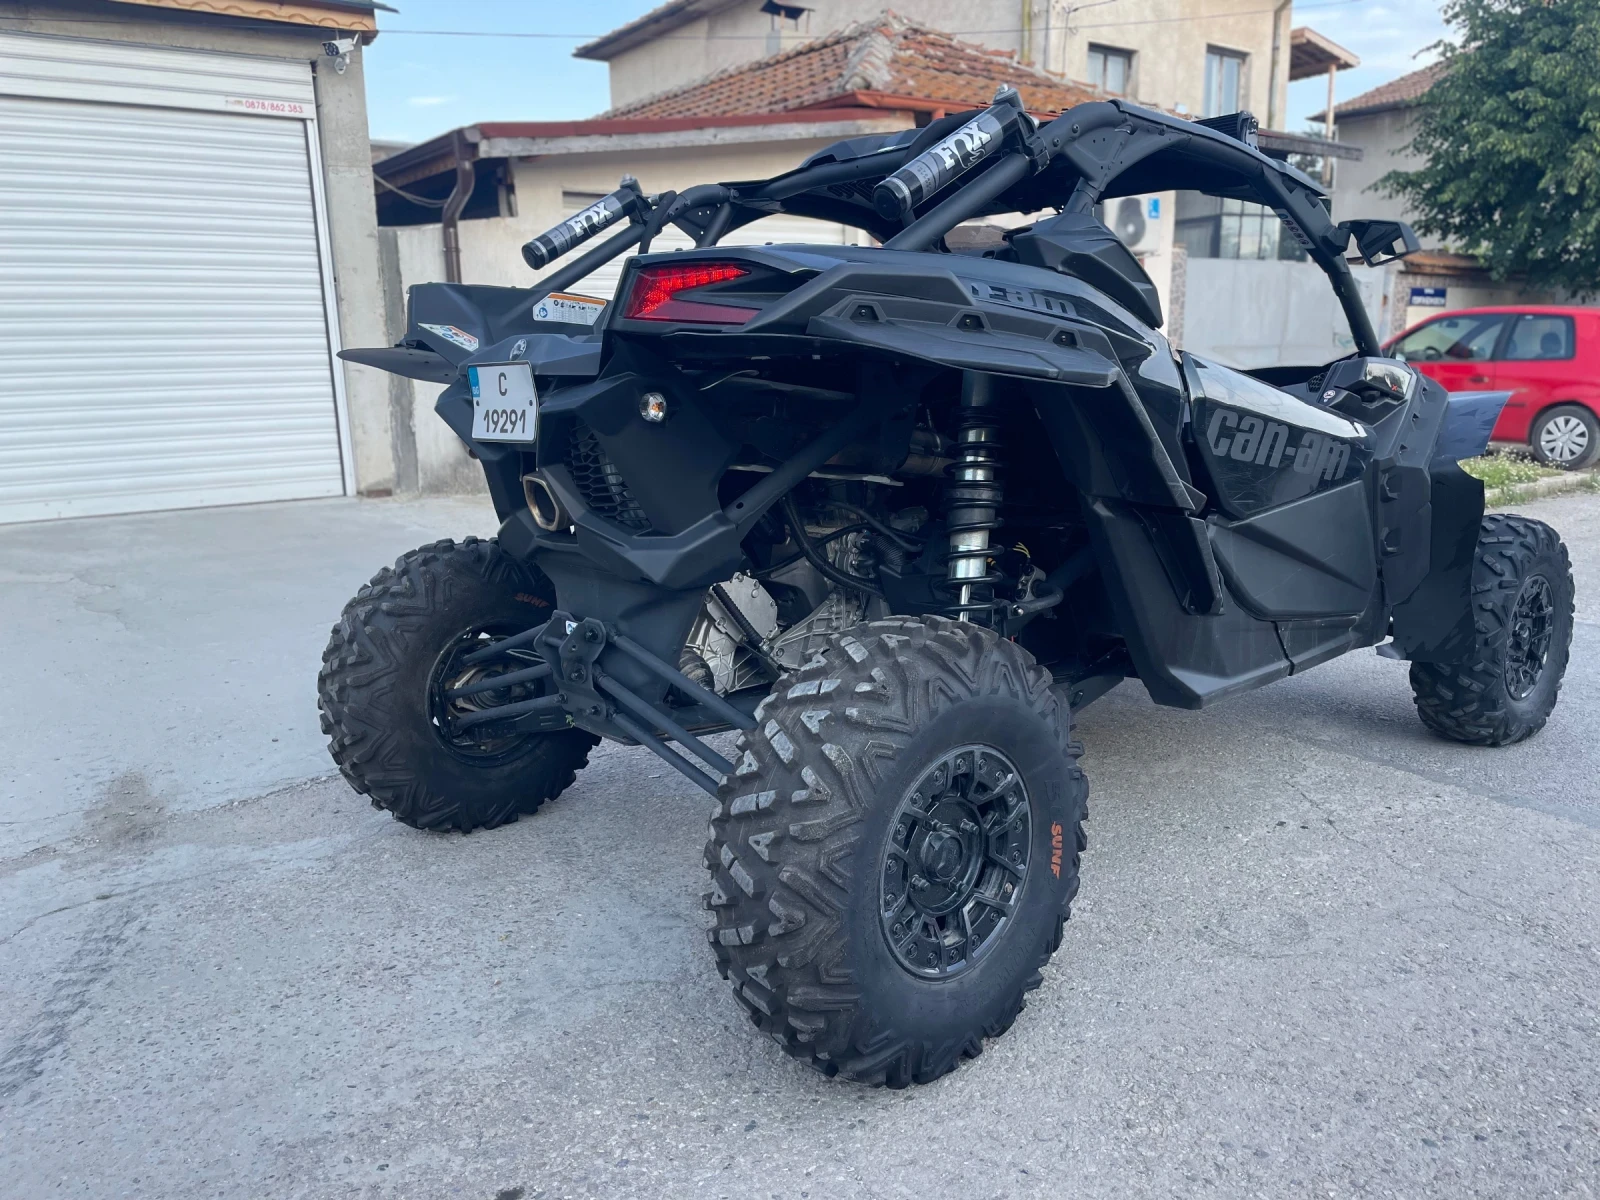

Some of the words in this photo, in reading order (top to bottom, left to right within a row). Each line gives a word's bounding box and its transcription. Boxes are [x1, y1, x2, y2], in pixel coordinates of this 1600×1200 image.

[244, 100, 287, 112] 0878/862
[287, 103, 304, 114] 383
[929, 121, 993, 171] FOX
[566, 201, 614, 238] FOX
[498, 371, 508, 397] C
[483, 408, 527, 434] 19291
[1050, 821, 1063, 880] SUNF
